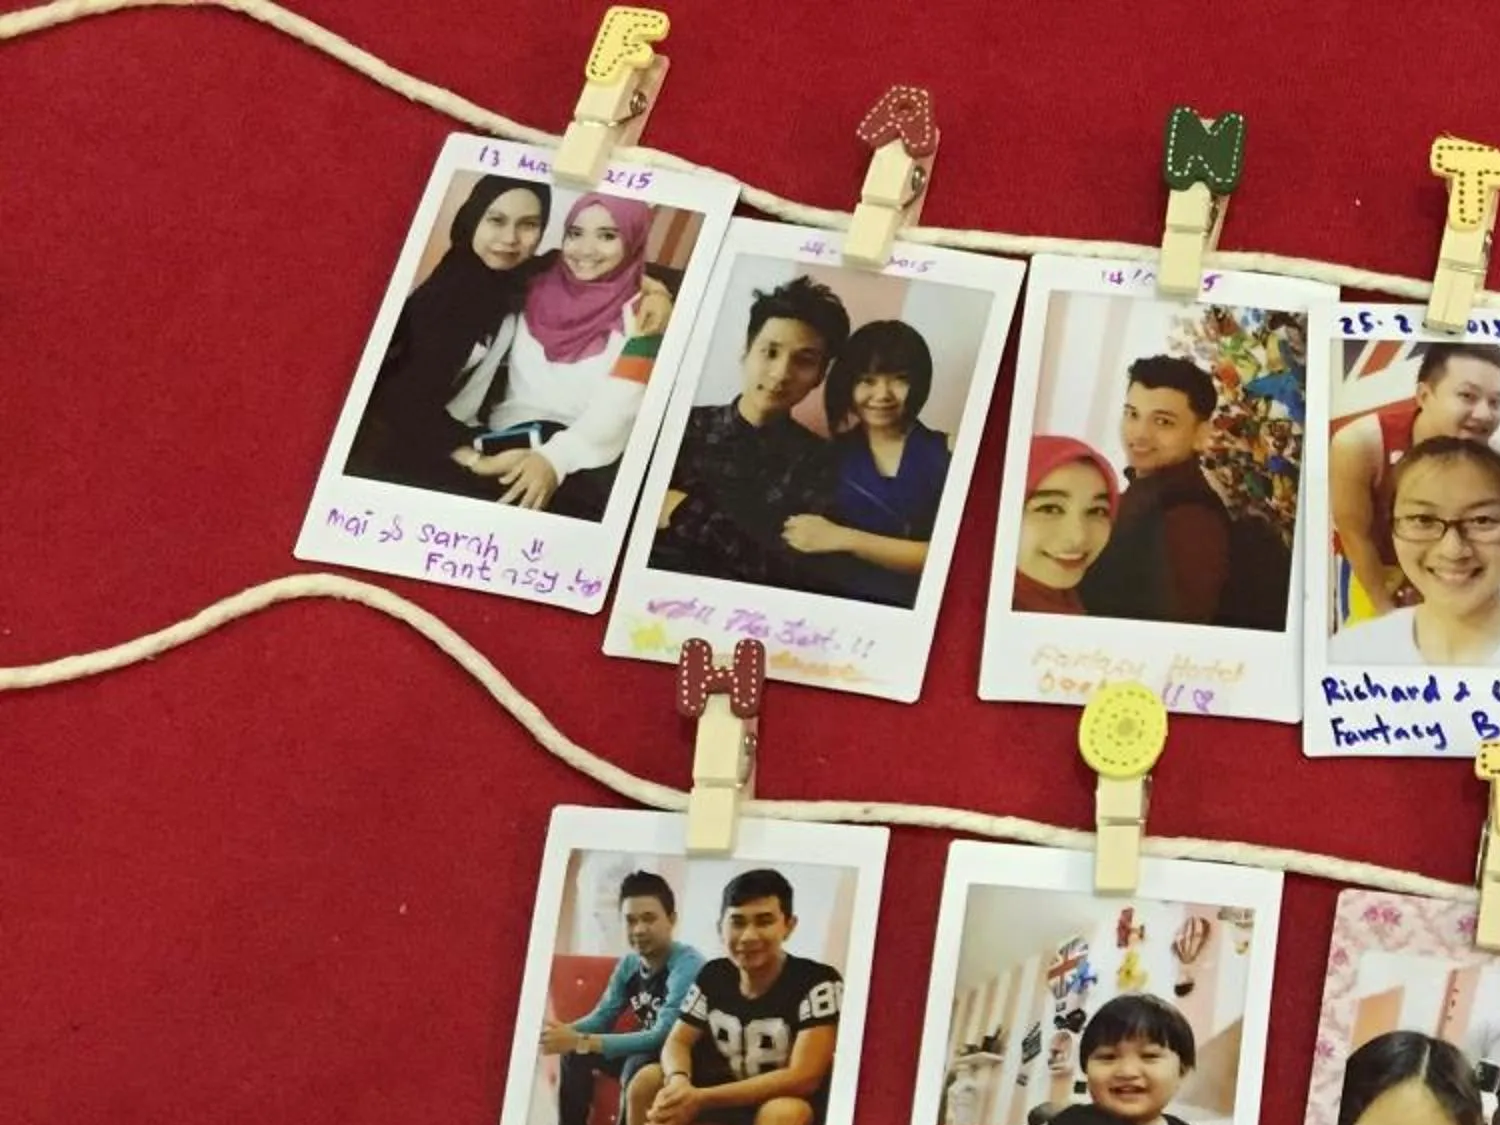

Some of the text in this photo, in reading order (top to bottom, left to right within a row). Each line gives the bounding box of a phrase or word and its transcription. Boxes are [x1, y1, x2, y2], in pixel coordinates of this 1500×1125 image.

[586, 5, 670, 83] F
[1163, 106, 1246, 195] N
[676, 637, 766, 719] H
[1321, 671, 1442, 707] Richard
[1329, 713, 1448, 751] Fantasy
